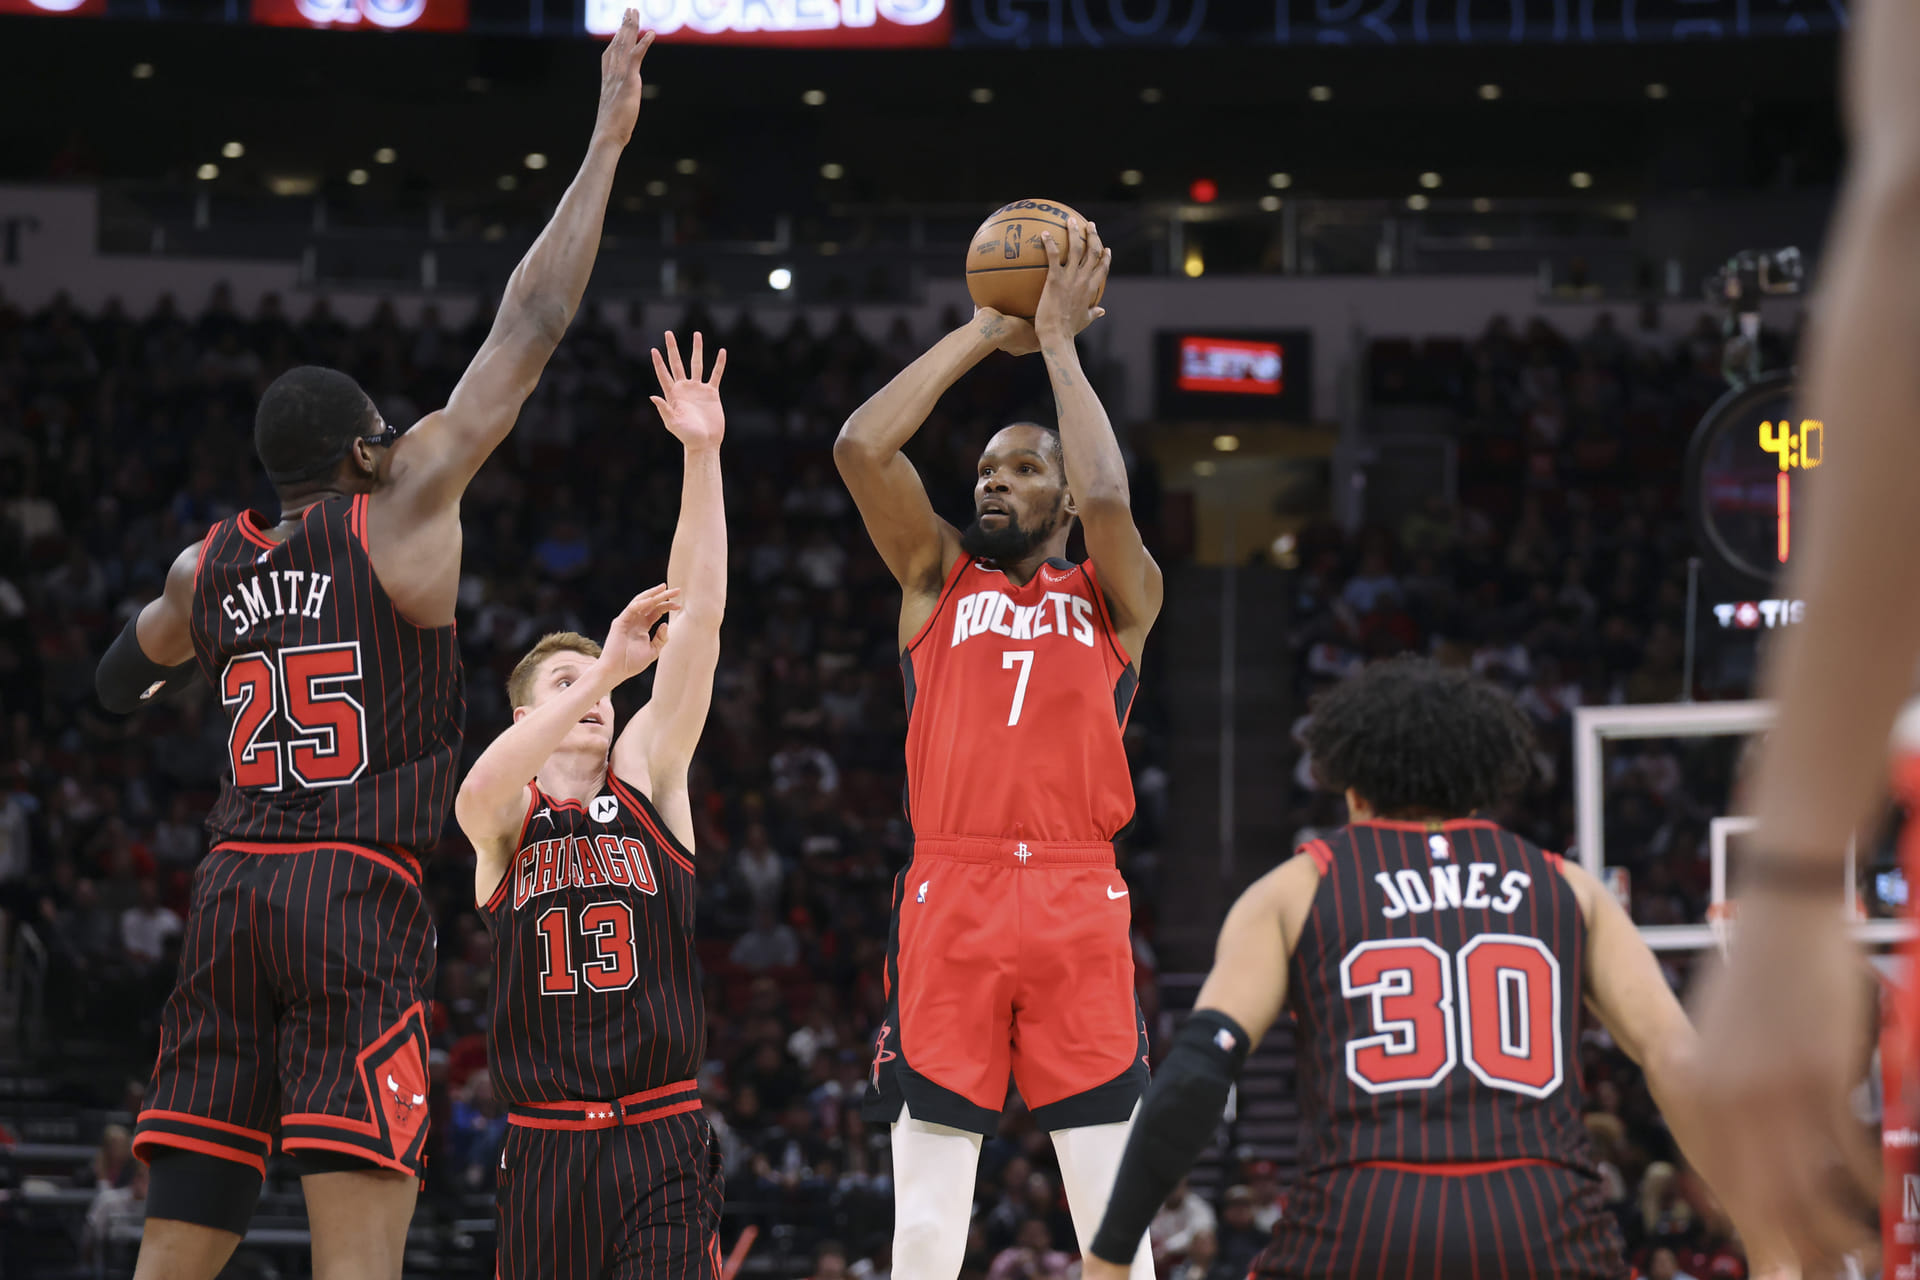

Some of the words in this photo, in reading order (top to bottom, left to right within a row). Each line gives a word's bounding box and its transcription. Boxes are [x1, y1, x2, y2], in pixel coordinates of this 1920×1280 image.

[222, 570, 331, 635] SMITH
[951, 591, 1094, 648] ROCKETS
[221, 641, 368, 792] 25
[1002, 650, 1034, 726] 7
[514, 833, 658, 911] CHIAGO
[1375, 863, 1531, 918] JONES
[537, 900, 638, 995] 13
[1339, 933, 1563, 1099] 30
